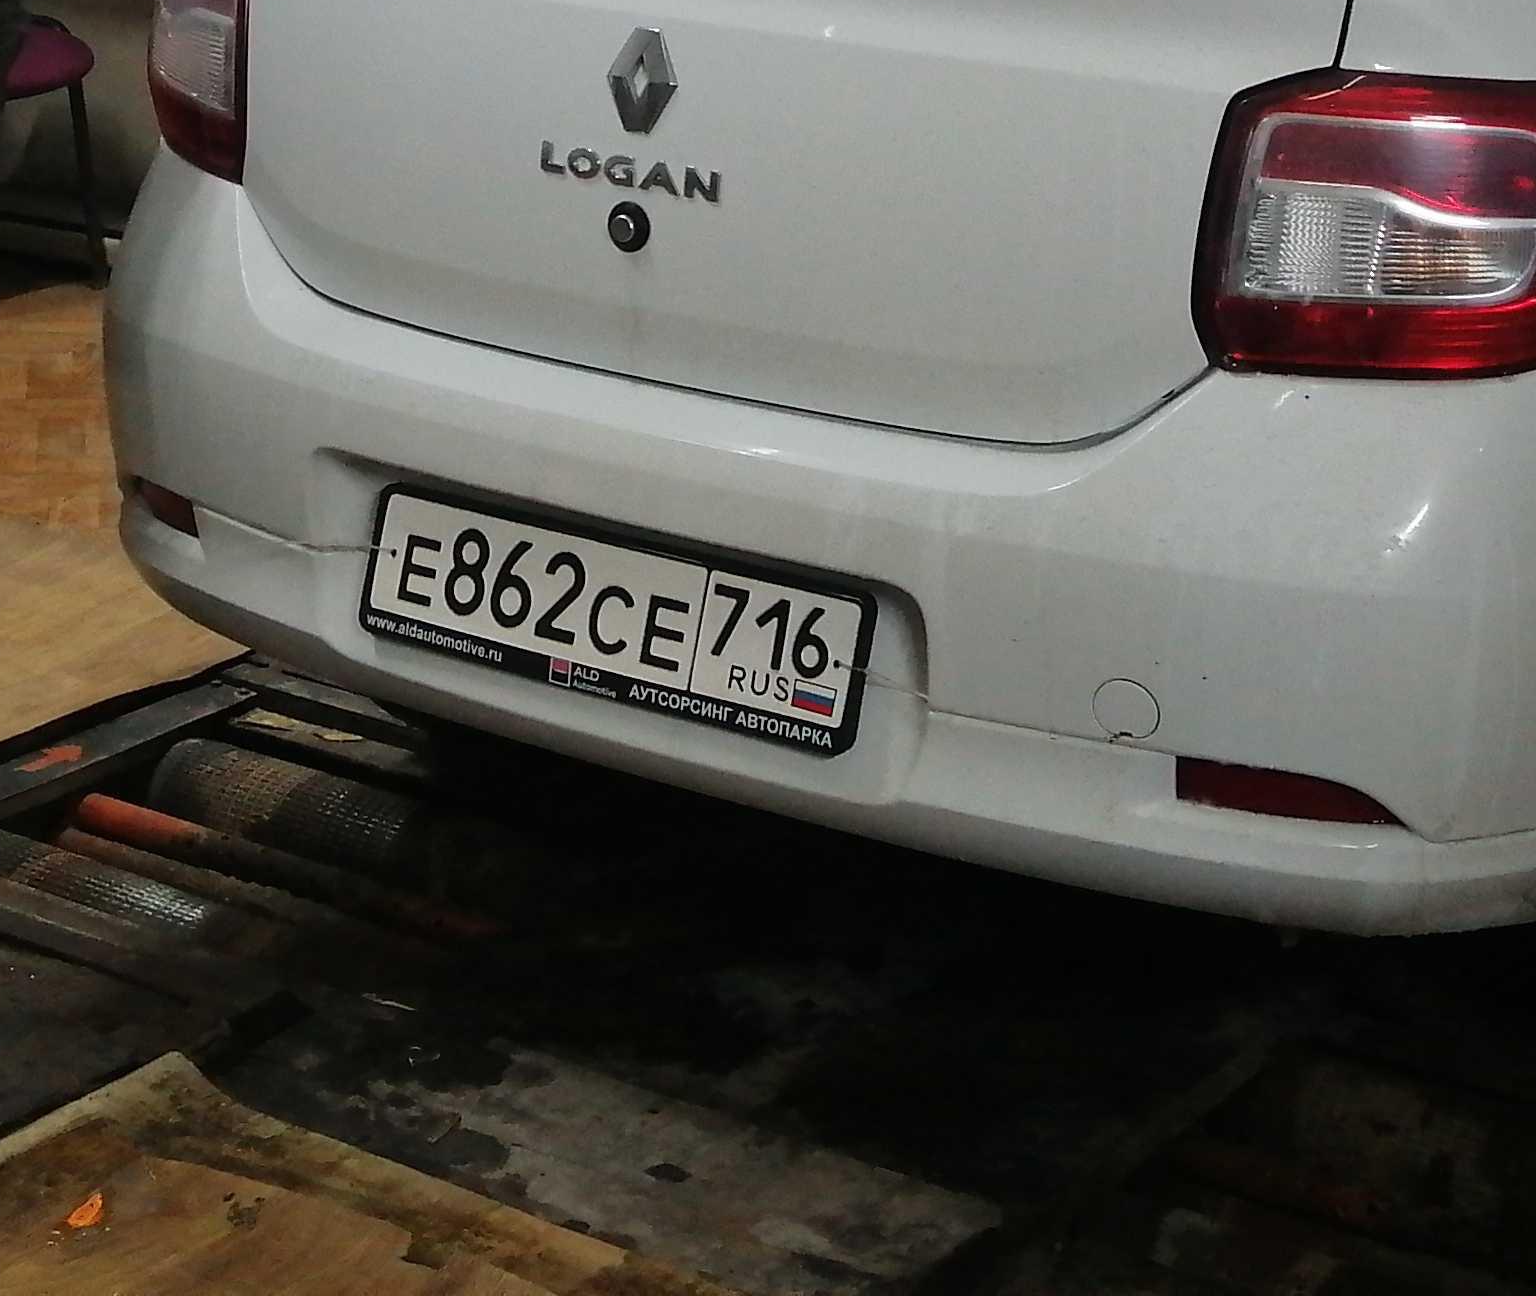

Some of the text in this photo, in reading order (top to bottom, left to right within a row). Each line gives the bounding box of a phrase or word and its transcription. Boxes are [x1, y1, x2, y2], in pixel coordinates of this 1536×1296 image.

[539, 139, 722, 207] LOGAN
[366, 612, 503, 663] www.aldautomotive.ru
[709, 583, 831, 680] 716
[573, 666, 600, 682] ALD
[727, 664, 790, 702] RUS
[628, 682, 833, 749] АУТСОРСИНГ АВТОПАРКА
